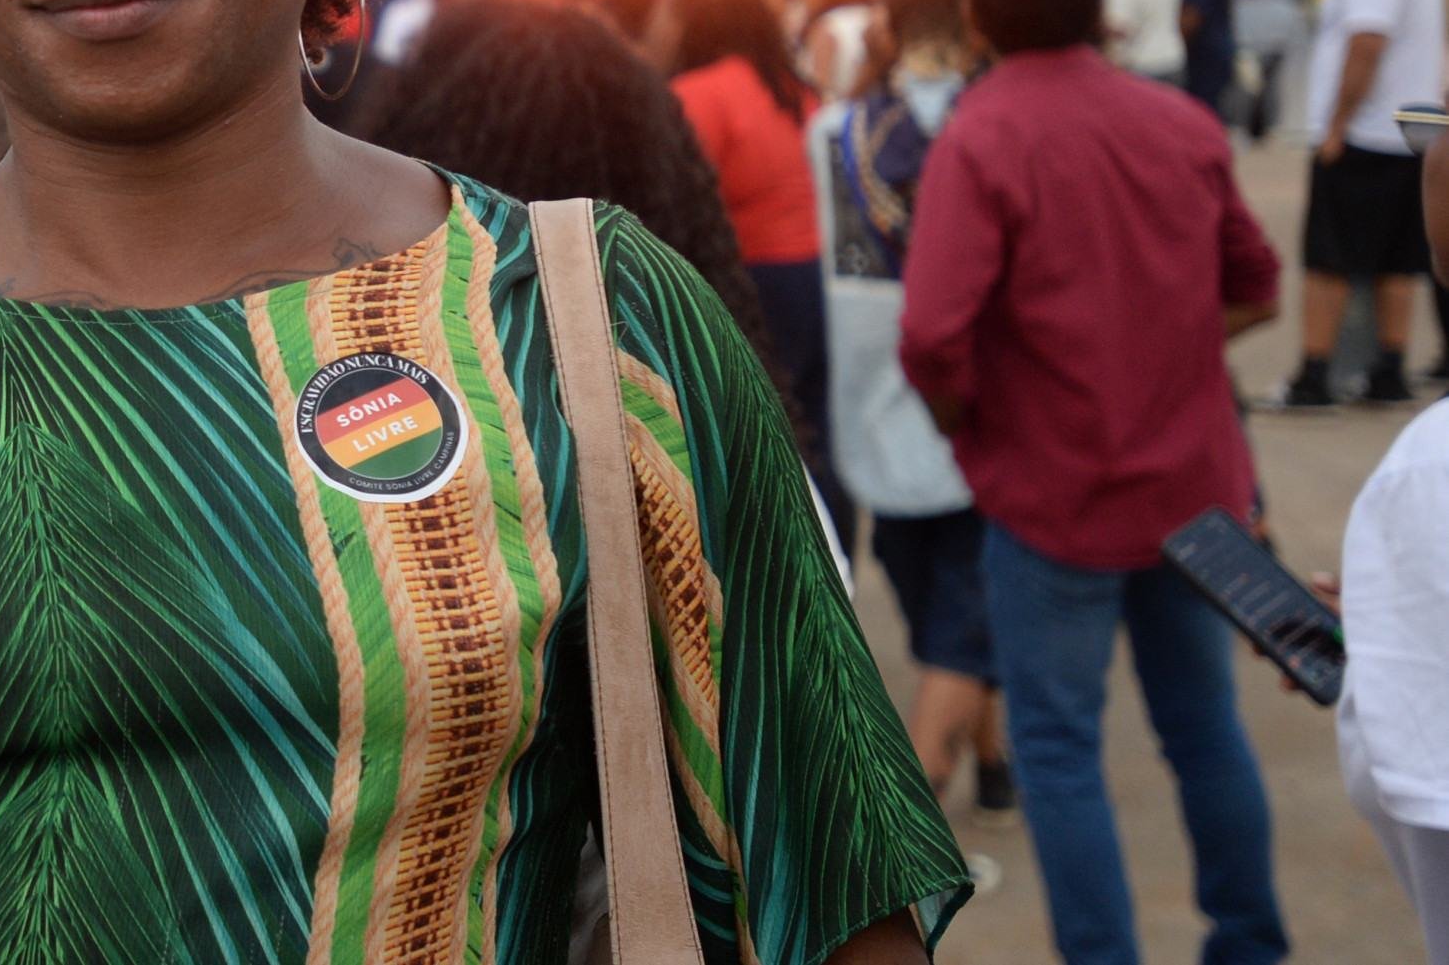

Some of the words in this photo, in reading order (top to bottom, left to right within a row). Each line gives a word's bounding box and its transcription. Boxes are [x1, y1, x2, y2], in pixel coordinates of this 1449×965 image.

[301, 363, 346, 433] ESCRAVIDÃO
[344, 354, 393, 370] NUNCA
[396, 360, 429, 384] MAIS
[336, 392, 402, 427] SÔNIA
[352, 416, 418, 452] LIVRE
[414, 470, 434, 485] LIVRE
